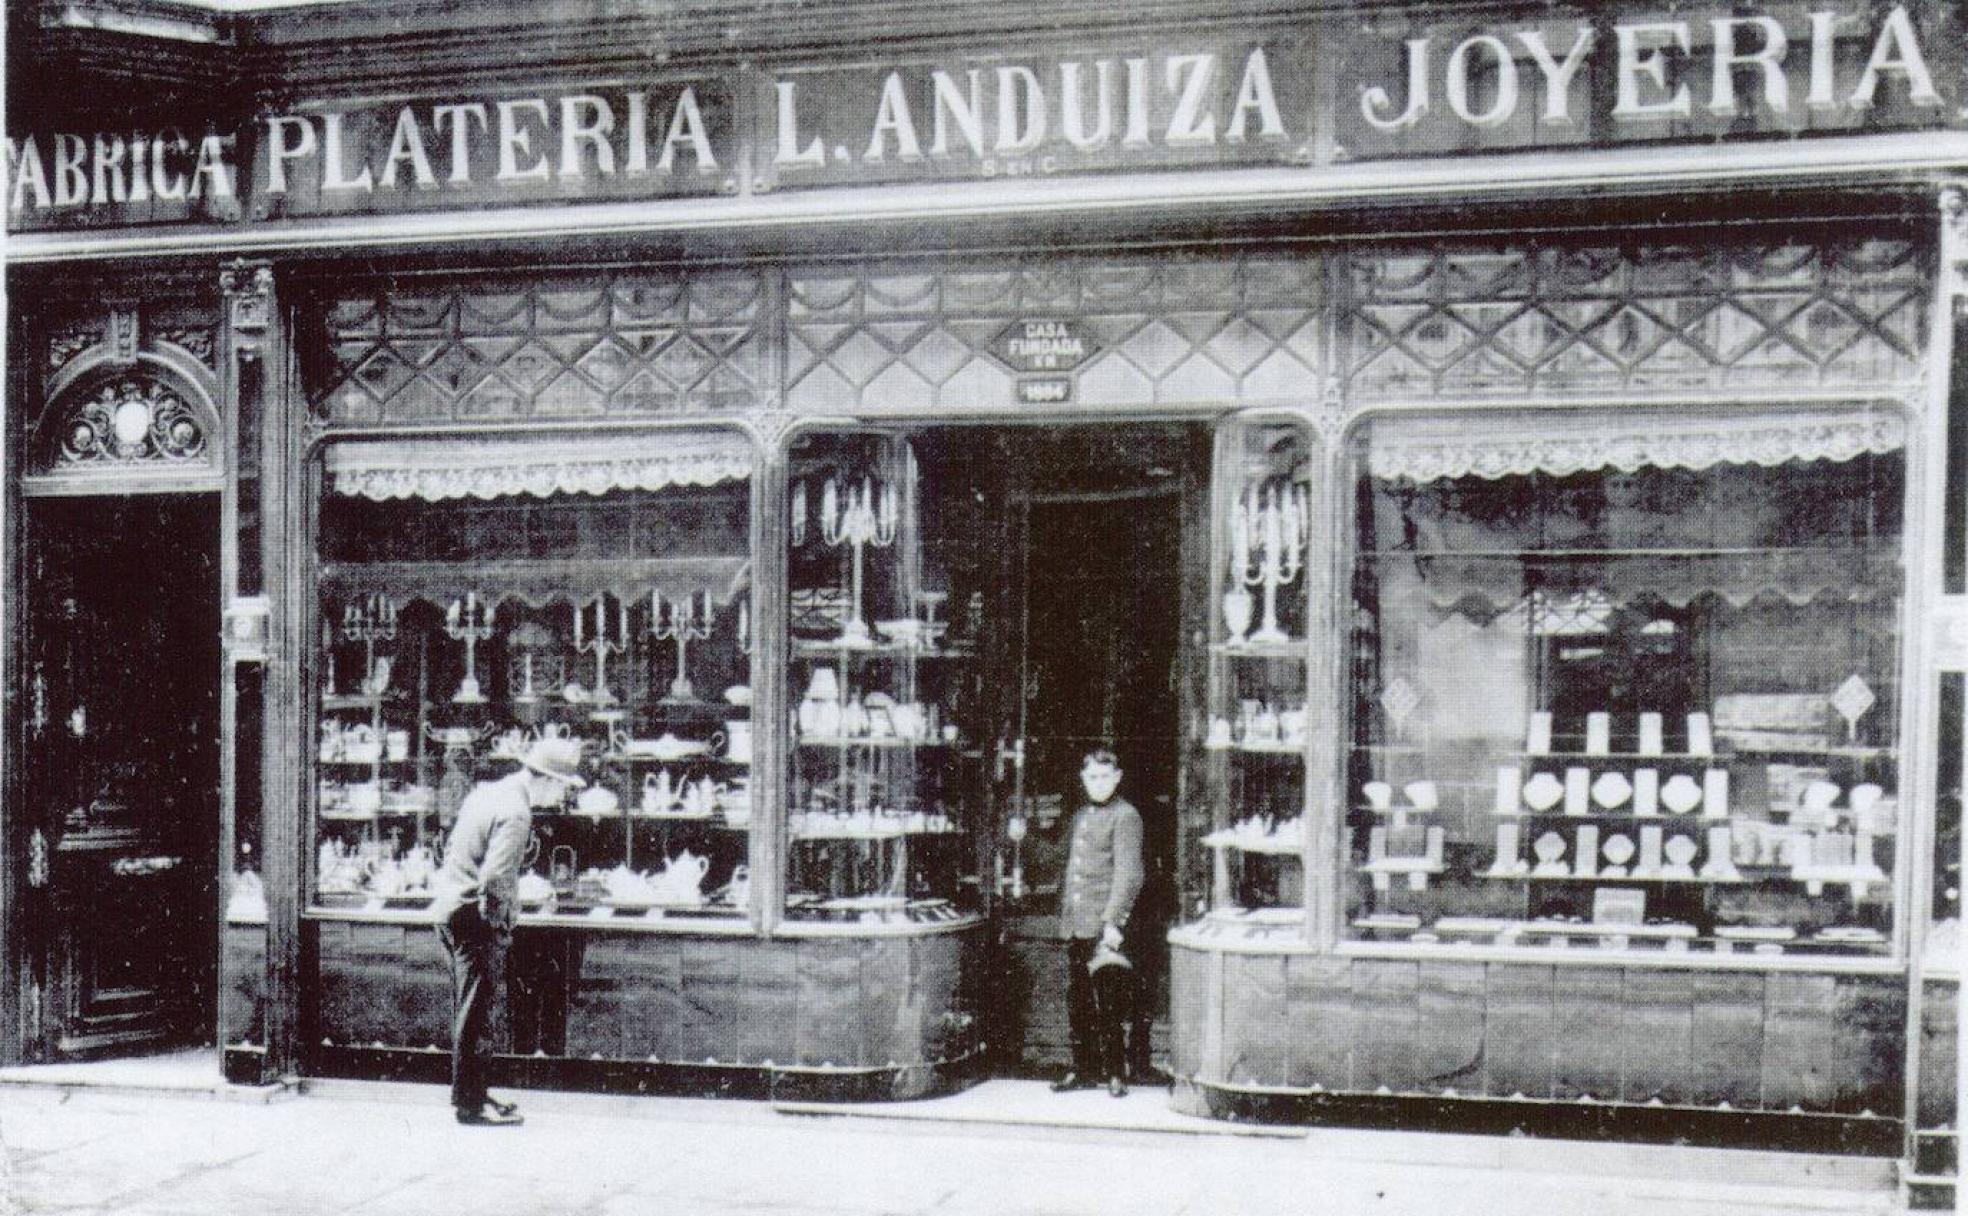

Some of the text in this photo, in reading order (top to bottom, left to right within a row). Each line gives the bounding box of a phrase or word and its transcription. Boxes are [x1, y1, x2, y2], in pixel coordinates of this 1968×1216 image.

[774, 46, 1291, 168] L. ANDUIZA
[1360, 5, 1944, 127] JOYERIA
[267, 87, 719, 193] PLATERIA
[1008, 338, 1083, 356] FUNDADA
[1026, 322, 1067, 338] CASA
